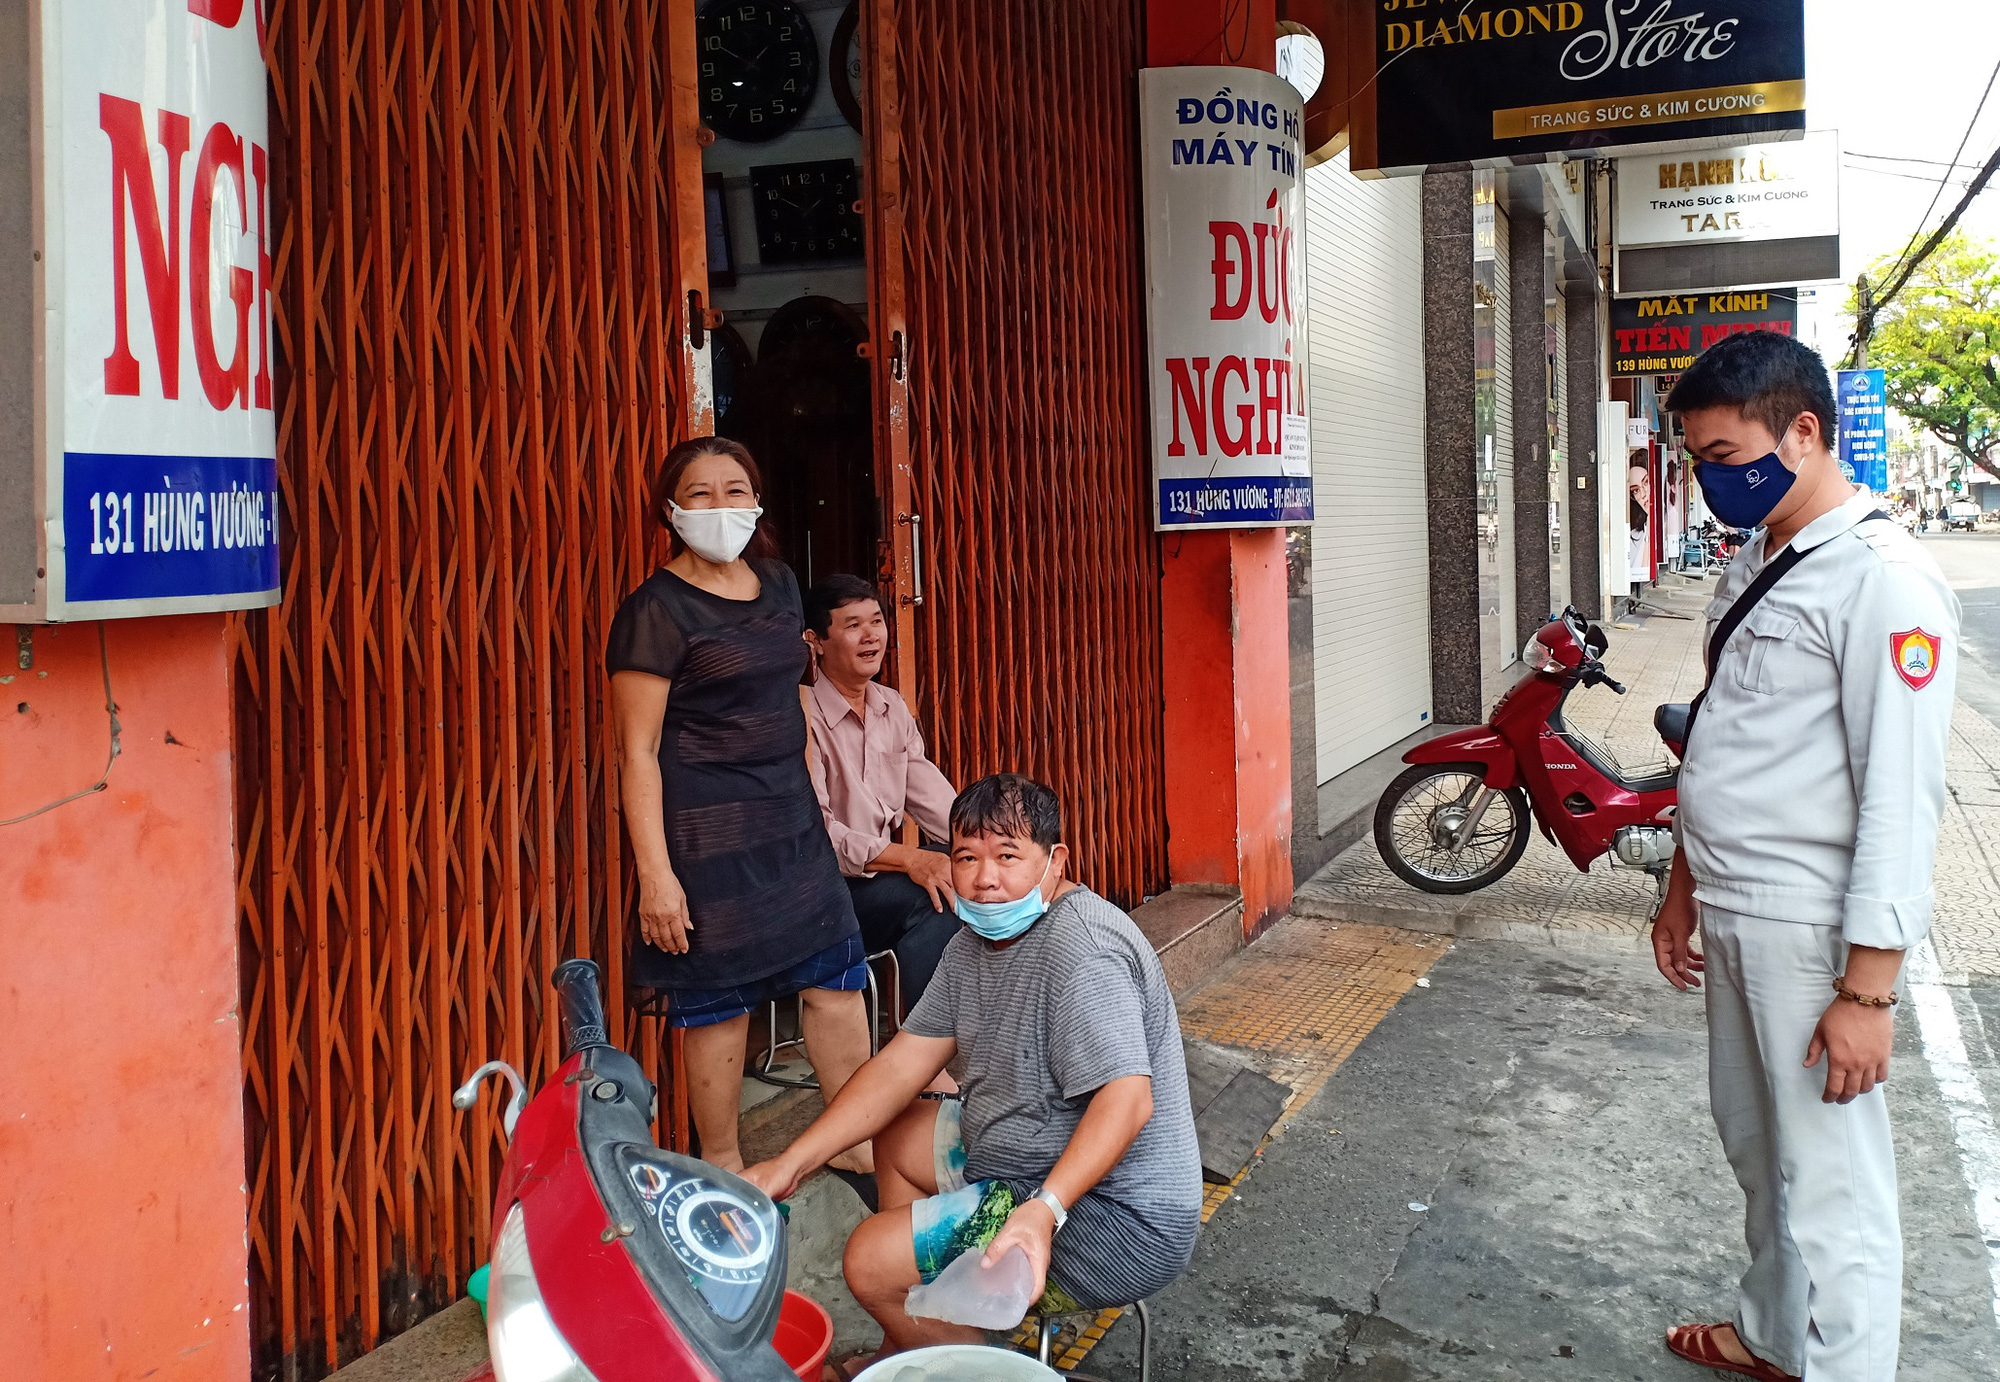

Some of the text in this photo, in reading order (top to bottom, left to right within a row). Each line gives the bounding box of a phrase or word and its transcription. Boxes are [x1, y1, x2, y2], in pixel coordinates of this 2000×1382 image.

[738, 6, 755, 21] 12
[719, 16, 732, 30] 11
[1385, 1, 1583, 51] DIAMOND
[780, 26, 792, 41] 2
[1560, 0, 1739, 81] Store
[705, 36, 720, 51] 10
[789, 51, 801, 67] 3
[702, 62, 714, 77] 9
[783, 79, 796, 92] 4
[711, 87, 723, 101] 8
[726, 103, 738, 118] 7
[773, 99, 784, 114] 5
[1176, 87, 1278, 130] ĐỒNG
[1530, 93, 1765, 128] TRANG SỨC & KIM CƯƠNG
[750, 108, 763, 123] 6
[1172, 131, 1297, 178] MÁY TÍN
[1659, 158, 1734, 192] HẠNH
[1725, 195, 1735, 204] &
[1709, 292, 1768, 313] KÍNH
[1615, 319, 1691, 353] TIẾN
[1616, 359, 1635, 372] 139
[1638, 355, 1667, 371] HÙNG
[1169, 490, 1192, 512] 131
[1196, 484, 1231, 512] HÙNG
[1233, 484, 1268, 510] VƯƠNG
[89, 491, 135, 554] 131
[143, 475, 205, 552] HÙNG
[210, 479, 265, 549] VƯƠNG
